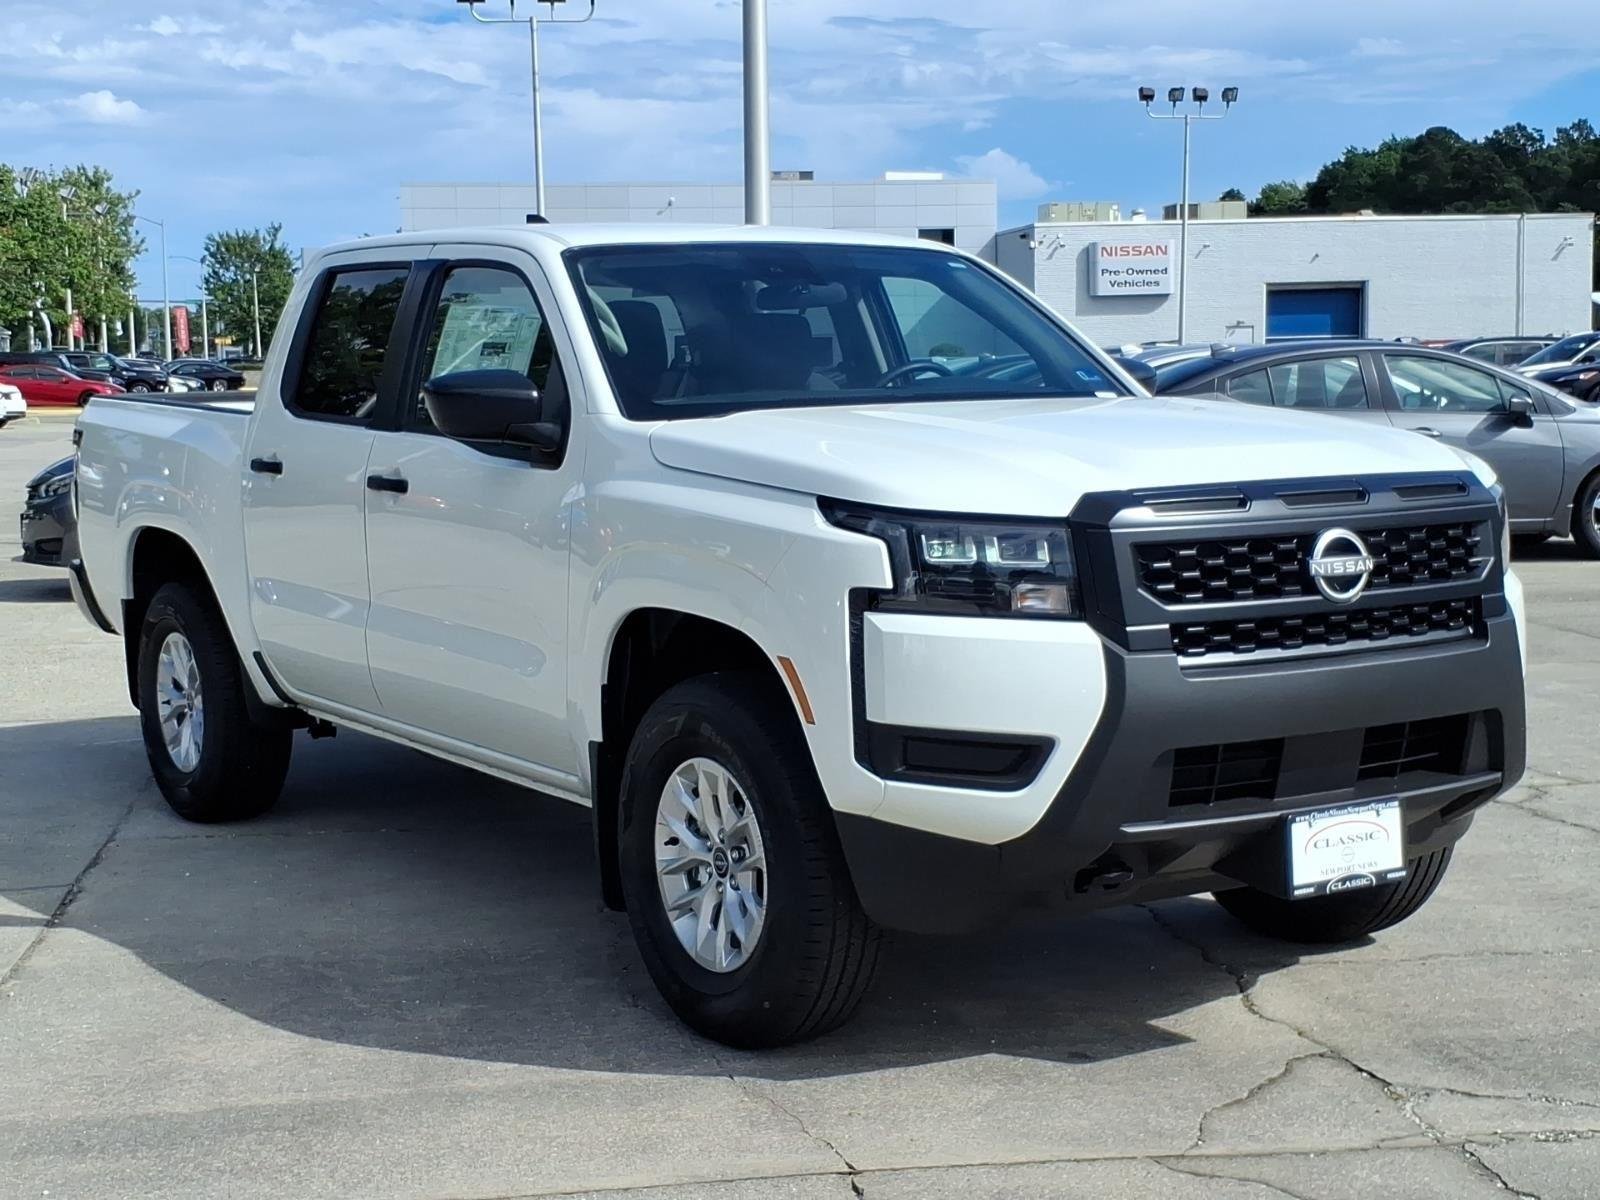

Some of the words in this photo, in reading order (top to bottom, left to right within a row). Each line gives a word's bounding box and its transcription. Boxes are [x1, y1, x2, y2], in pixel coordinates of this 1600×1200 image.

[1101, 245, 1168, 257] NISSAN
[1101, 267, 1168, 277] Pre-Owned
[1109, 279, 1160, 288] Vehicles
[1311, 559, 1373, 574] NISSAN
[1313, 831, 1381, 850] CLASSIC
[1331, 877, 1371, 890] CLASSIC
